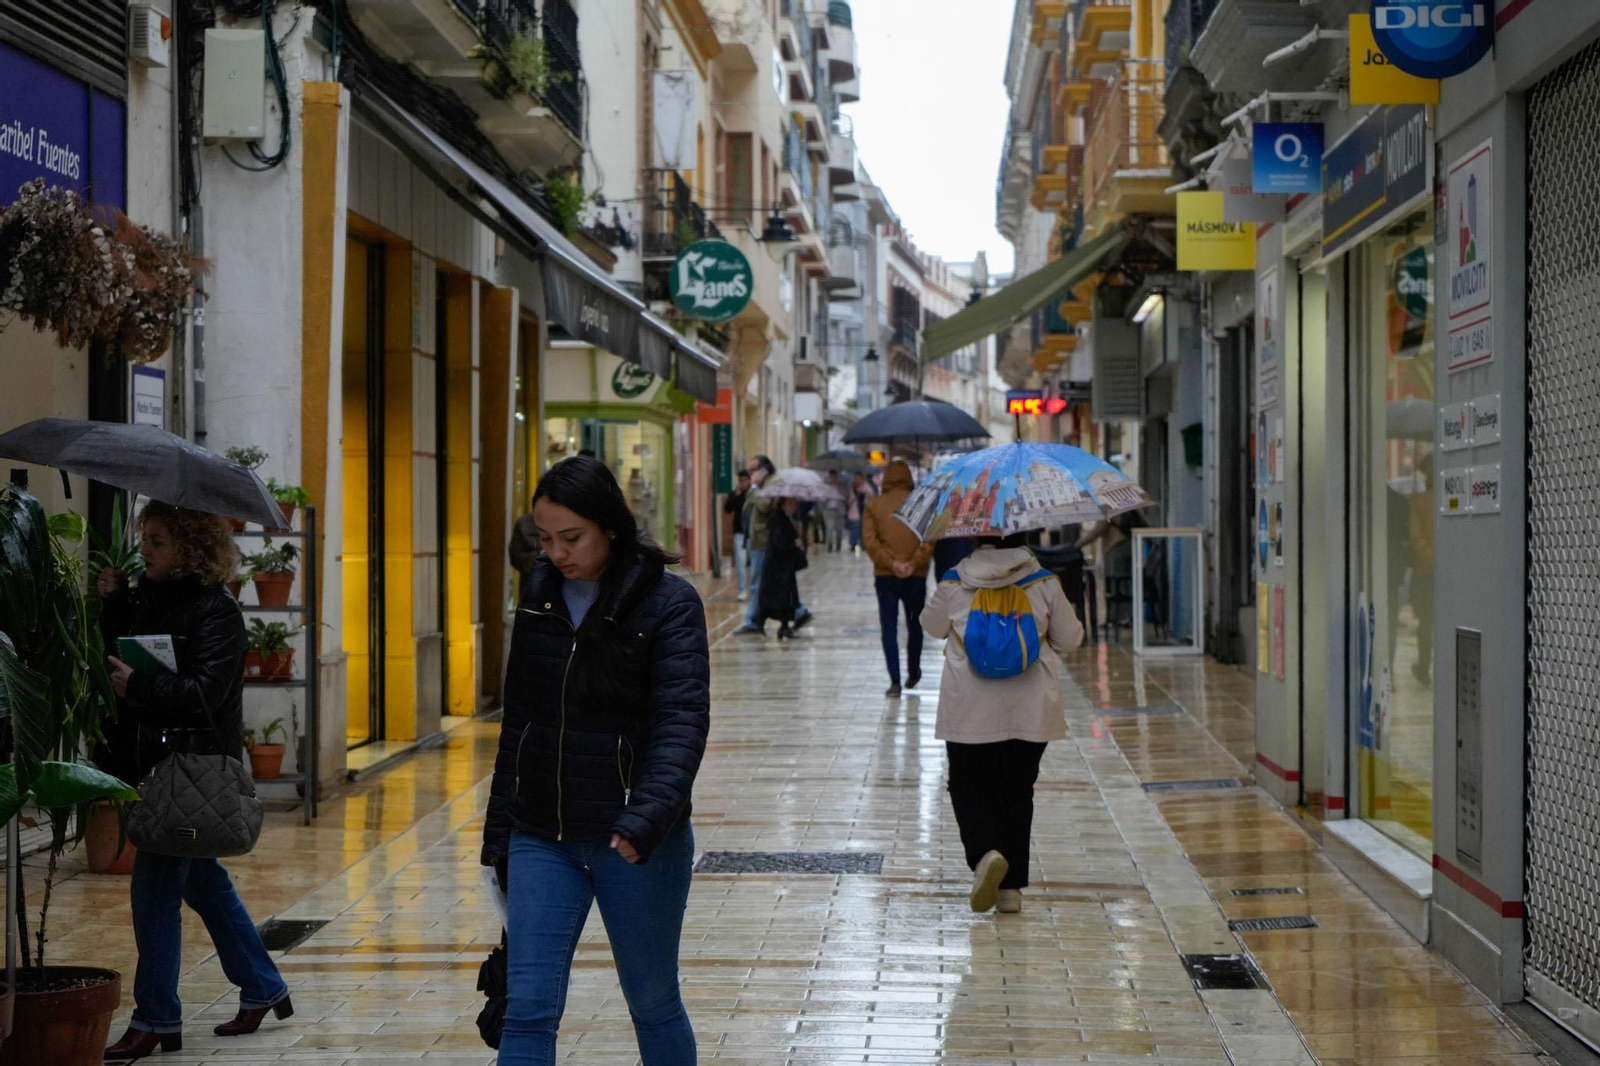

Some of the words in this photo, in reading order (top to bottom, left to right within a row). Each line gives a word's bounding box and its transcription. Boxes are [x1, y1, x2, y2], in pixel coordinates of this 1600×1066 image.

[1374, 4, 1485, 29] DIGI
[0, 119, 34, 162] aribel
[37, 129, 80, 180] Fuentes
